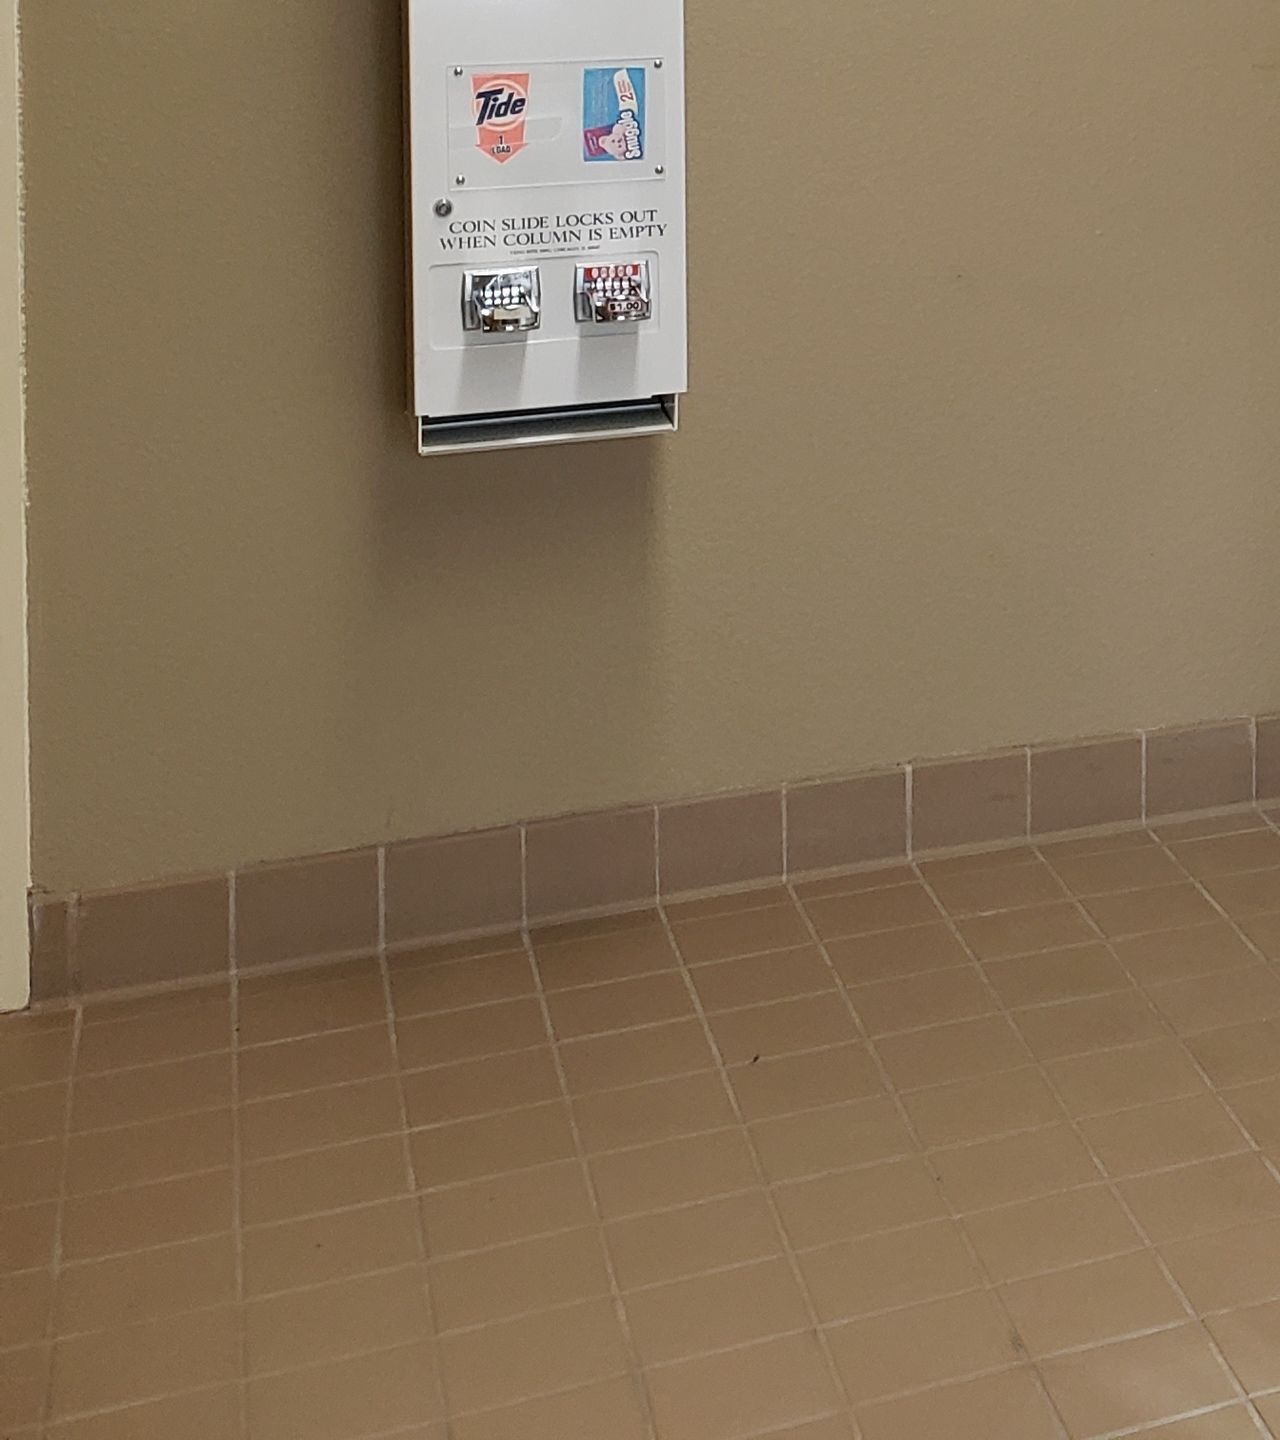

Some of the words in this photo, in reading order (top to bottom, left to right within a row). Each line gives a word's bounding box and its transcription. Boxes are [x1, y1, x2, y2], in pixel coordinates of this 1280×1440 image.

[476, 87, 526, 126] Tide
[499, 136, 503, 145] 1
[618, 110, 641, 159] Snuggle
[450, 220, 496, 234] COIN
[501, 216, 549, 231] SLIDE
[556, 212, 614, 228] LOCKS
[620, 210, 658, 223] OUT
[440, 234, 496, 250] WHEN
[503, 229, 581, 246] COLUMN
[589, 228, 602, 241] IS
[609, 224, 667, 239] EMPTY
